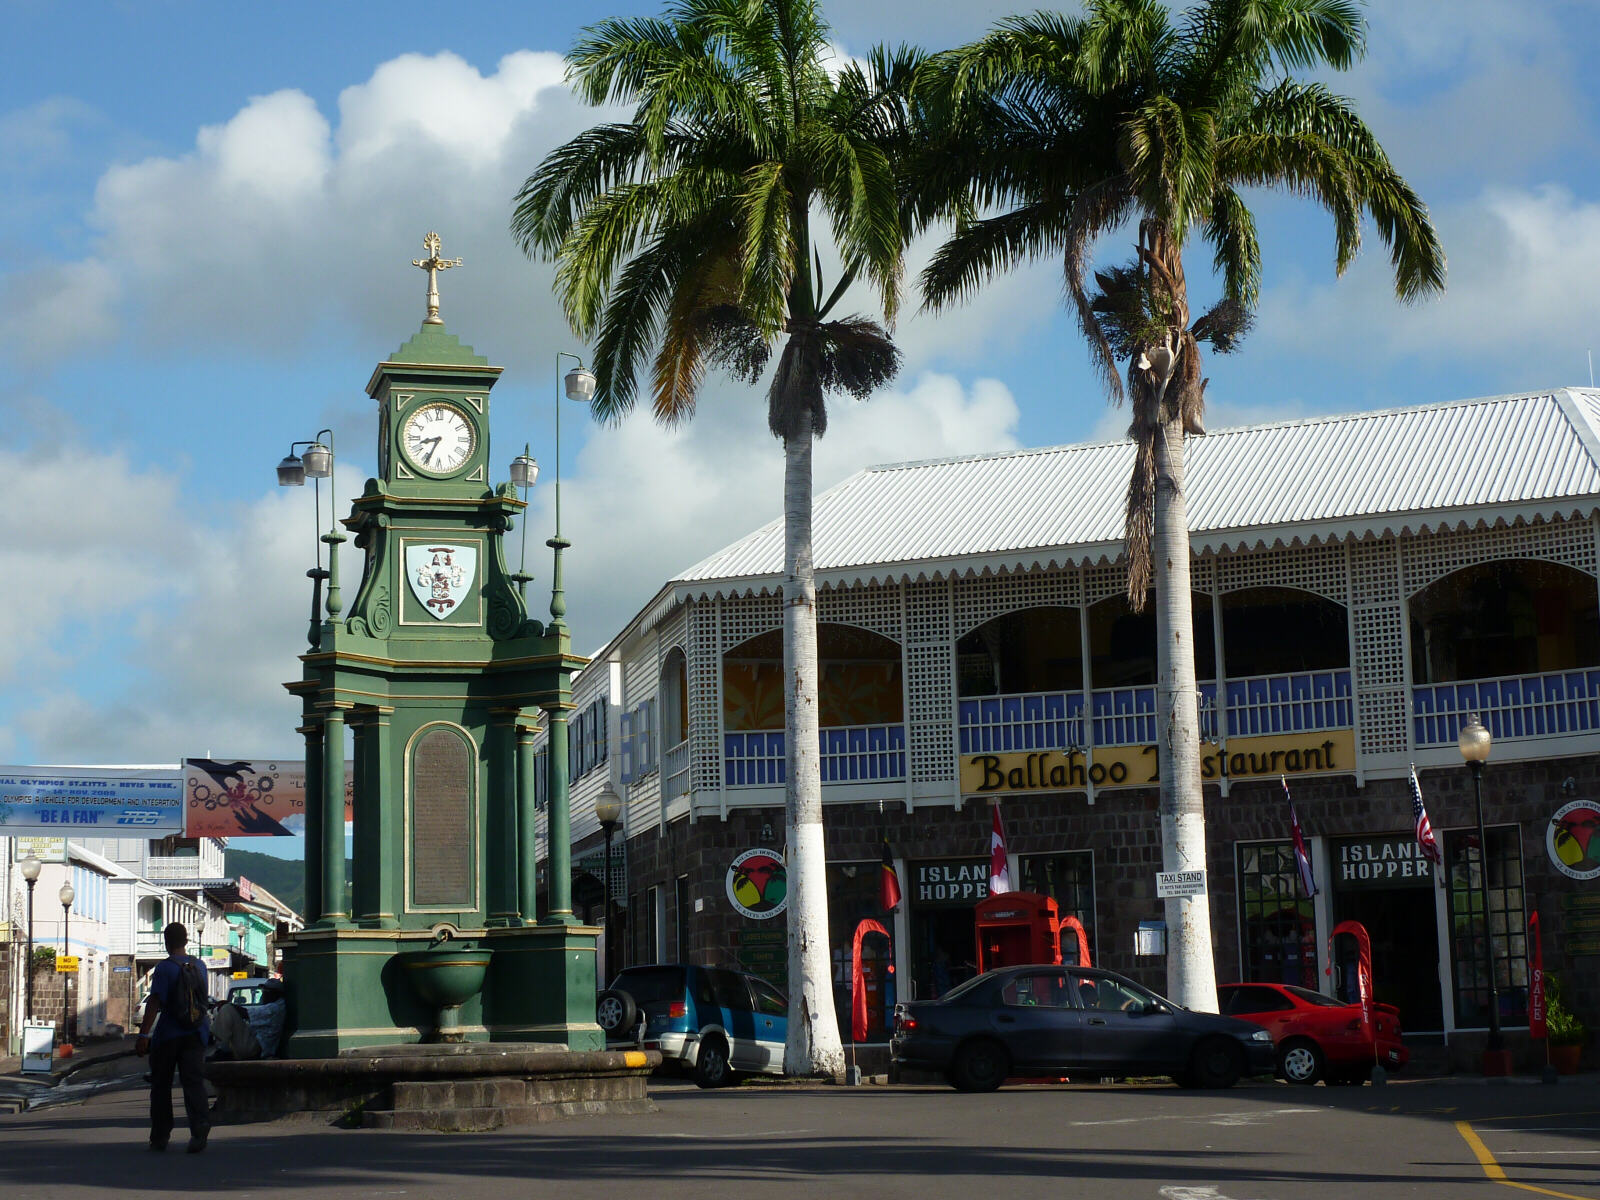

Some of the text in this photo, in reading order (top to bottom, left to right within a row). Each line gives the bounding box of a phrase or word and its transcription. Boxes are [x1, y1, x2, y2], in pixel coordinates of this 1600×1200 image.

[435, 407, 444, 421] XII
[970, 740, 1335, 791] Ballahoo staurant
[42, 796, 66, 804] VEHICLE
[68, 796, 79, 805] FOR
[81, 797, 125, 806] DEVELOPMENT
[128, 798, 139, 806] AND
[142, 799, 180, 807] INTEGRATION
[61, 809, 70, 823] A
[920, 864, 992, 883] ISLAN
[1160, 872, 1202, 883] TAXI STAND
[1342, 860, 1429, 880] HOPPER
[920, 882, 987, 900] HOPPE
[1533, 969, 1542, 1021] SALE
